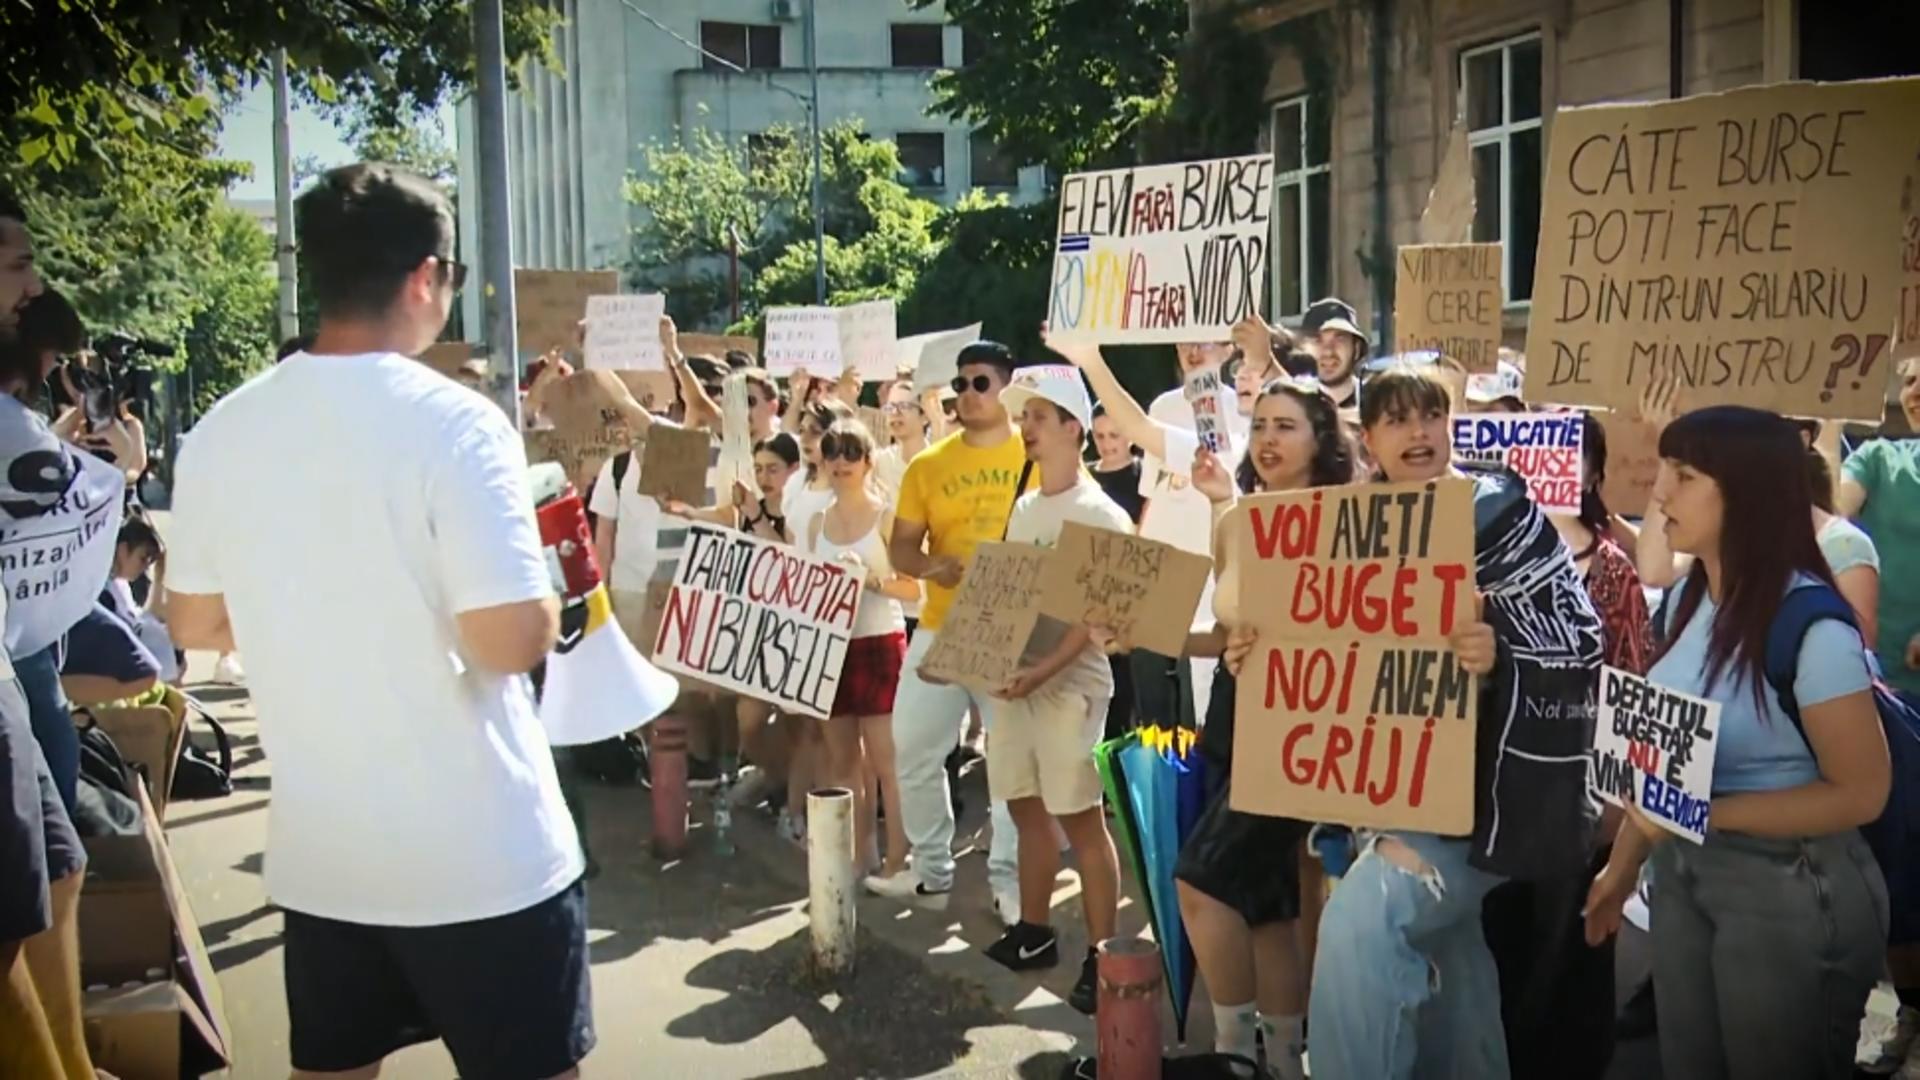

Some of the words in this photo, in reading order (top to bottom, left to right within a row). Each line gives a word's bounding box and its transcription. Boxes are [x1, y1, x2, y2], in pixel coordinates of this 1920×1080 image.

[1716, 110, 1866, 187] BURSE
[1062, 170, 1134, 238] ELEVI
[1178, 159, 1273, 232] BURSE
[1695, 201, 1798, 260] FACE
[1184, 233, 1263, 326] VIITOR
[1426, 289, 1492, 326] CERE
[1730, 267, 1868, 323] SALARIU
[1547, 341, 1593, 387] DE
[1507, 446, 1578, 478] BURSE
[1249, 490, 1323, 560] VOI
[1290, 562, 1467, 637] BUGET
[656, 586, 722, 672] NU
[706, 598, 847, 715] BURSELE
[1264, 641, 1361, 715] NOI
[1369, 649, 1470, 720] AVEM
[1605, 672, 1713, 742] DEFICITUL
[1612, 707, 1694, 763] BUGETAR
[1282, 715, 1435, 808] GRIJI
[1627, 737, 1660, 776] NU
[1666, 755, 1685, 789] E
[1641, 773, 1710, 836] ELEVILOR
